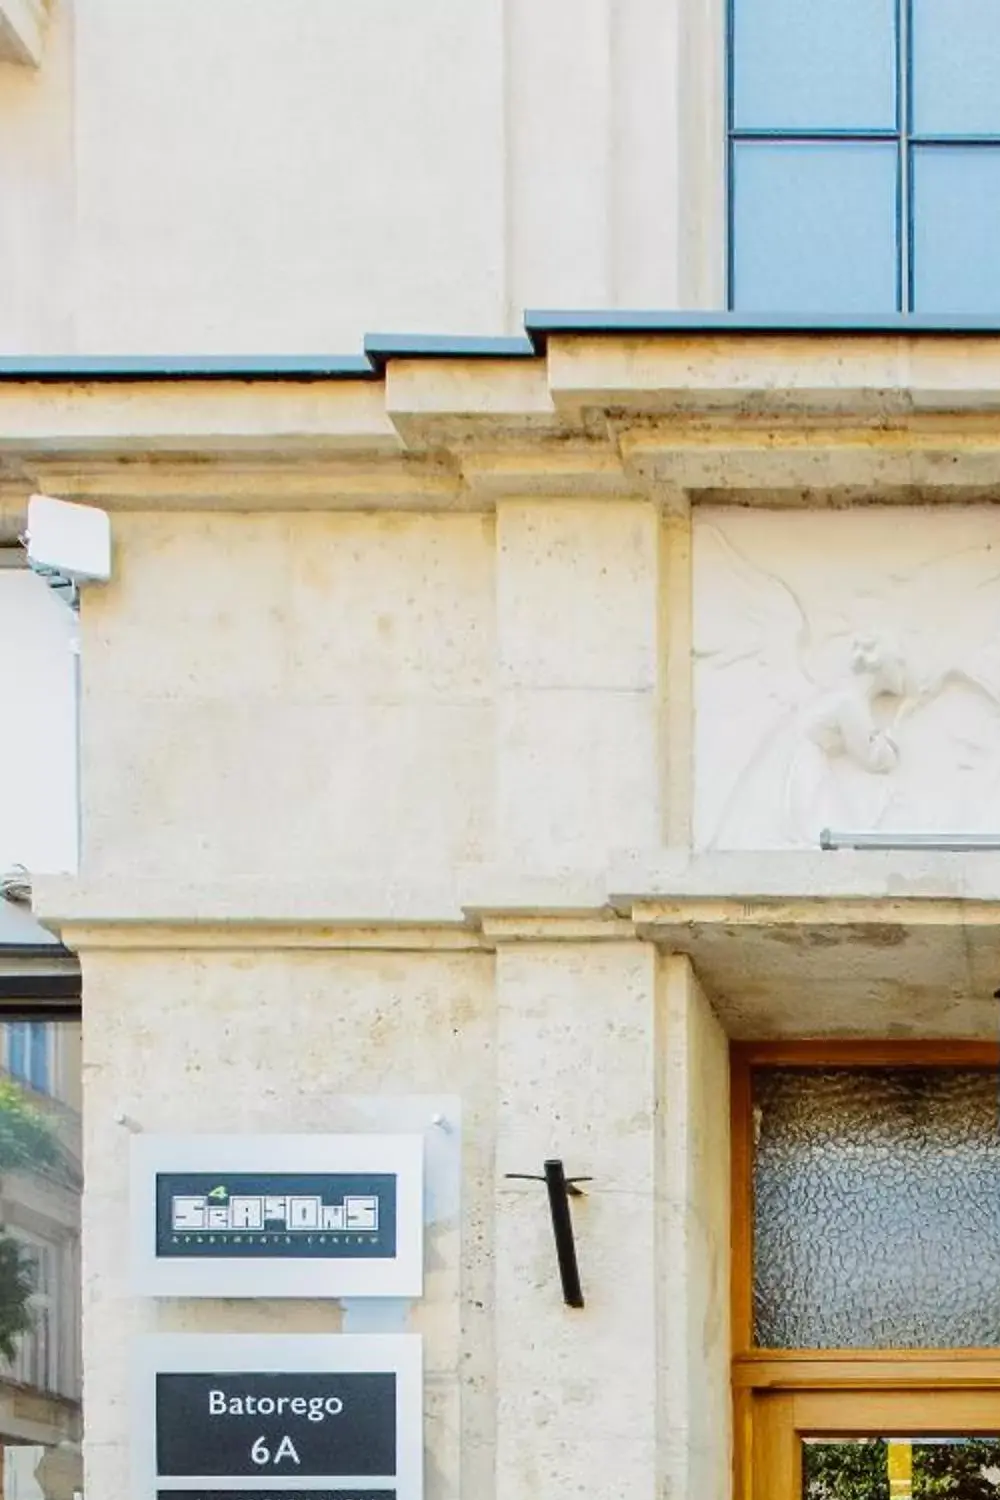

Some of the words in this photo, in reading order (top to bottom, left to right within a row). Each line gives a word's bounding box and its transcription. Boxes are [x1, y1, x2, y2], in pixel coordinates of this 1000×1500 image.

[208, 1185, 228, 1199] 4
[208, 1390, 344, 1421] Batorego
[250, 1435, 301, 1465] 6A
